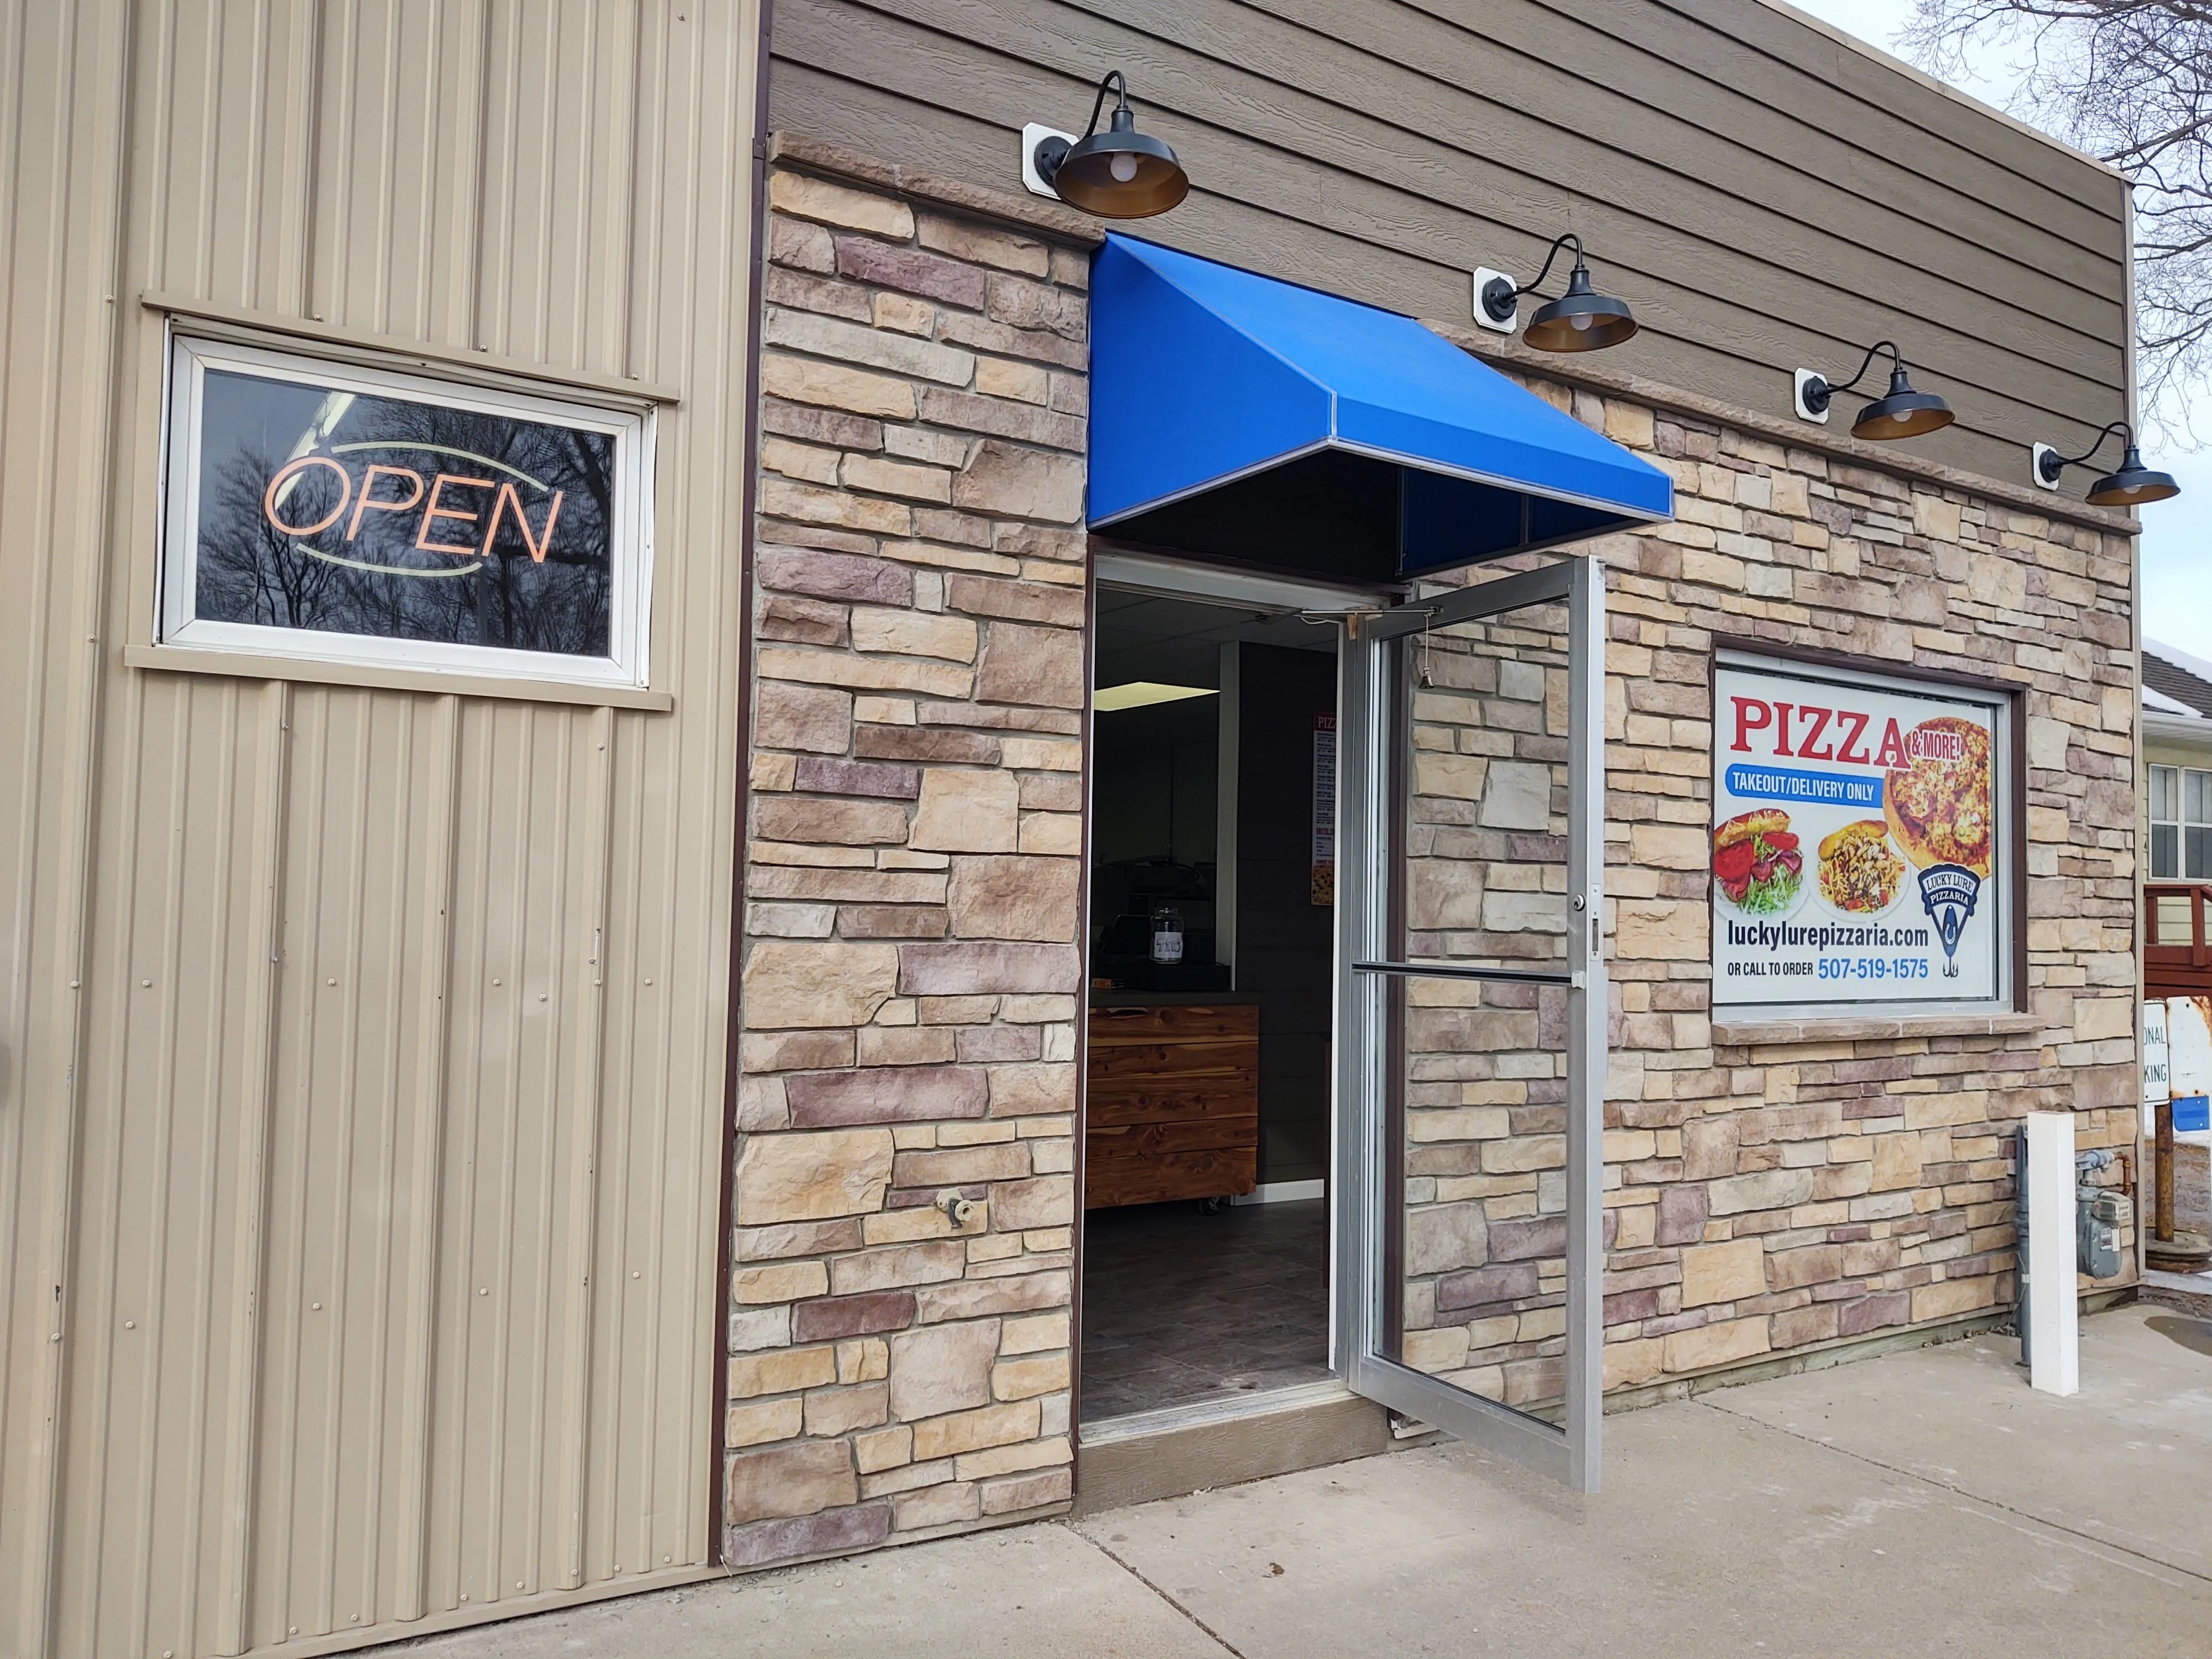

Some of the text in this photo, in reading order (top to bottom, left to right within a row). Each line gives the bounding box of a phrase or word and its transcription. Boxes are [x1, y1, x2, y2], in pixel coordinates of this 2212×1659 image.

[264, 457, 564, 563] OPEN
[1730, 696, 1960, 769] PIZZA & MORE!
[1733, 772, 1874, 801] TAKEOUT/DELIVERY ONLY
[1927, 874, 1973, 893] LUCKY LURE
[1930, 890, 1968, 905] PIZZARIA
[1156, 938, 1181, 952] TIPS
[1728, 920, 1928, 951] luckylurepizzaria.com
[1728, 958, 1928, 978] OR CALL TO ORDER 507-519-1575
